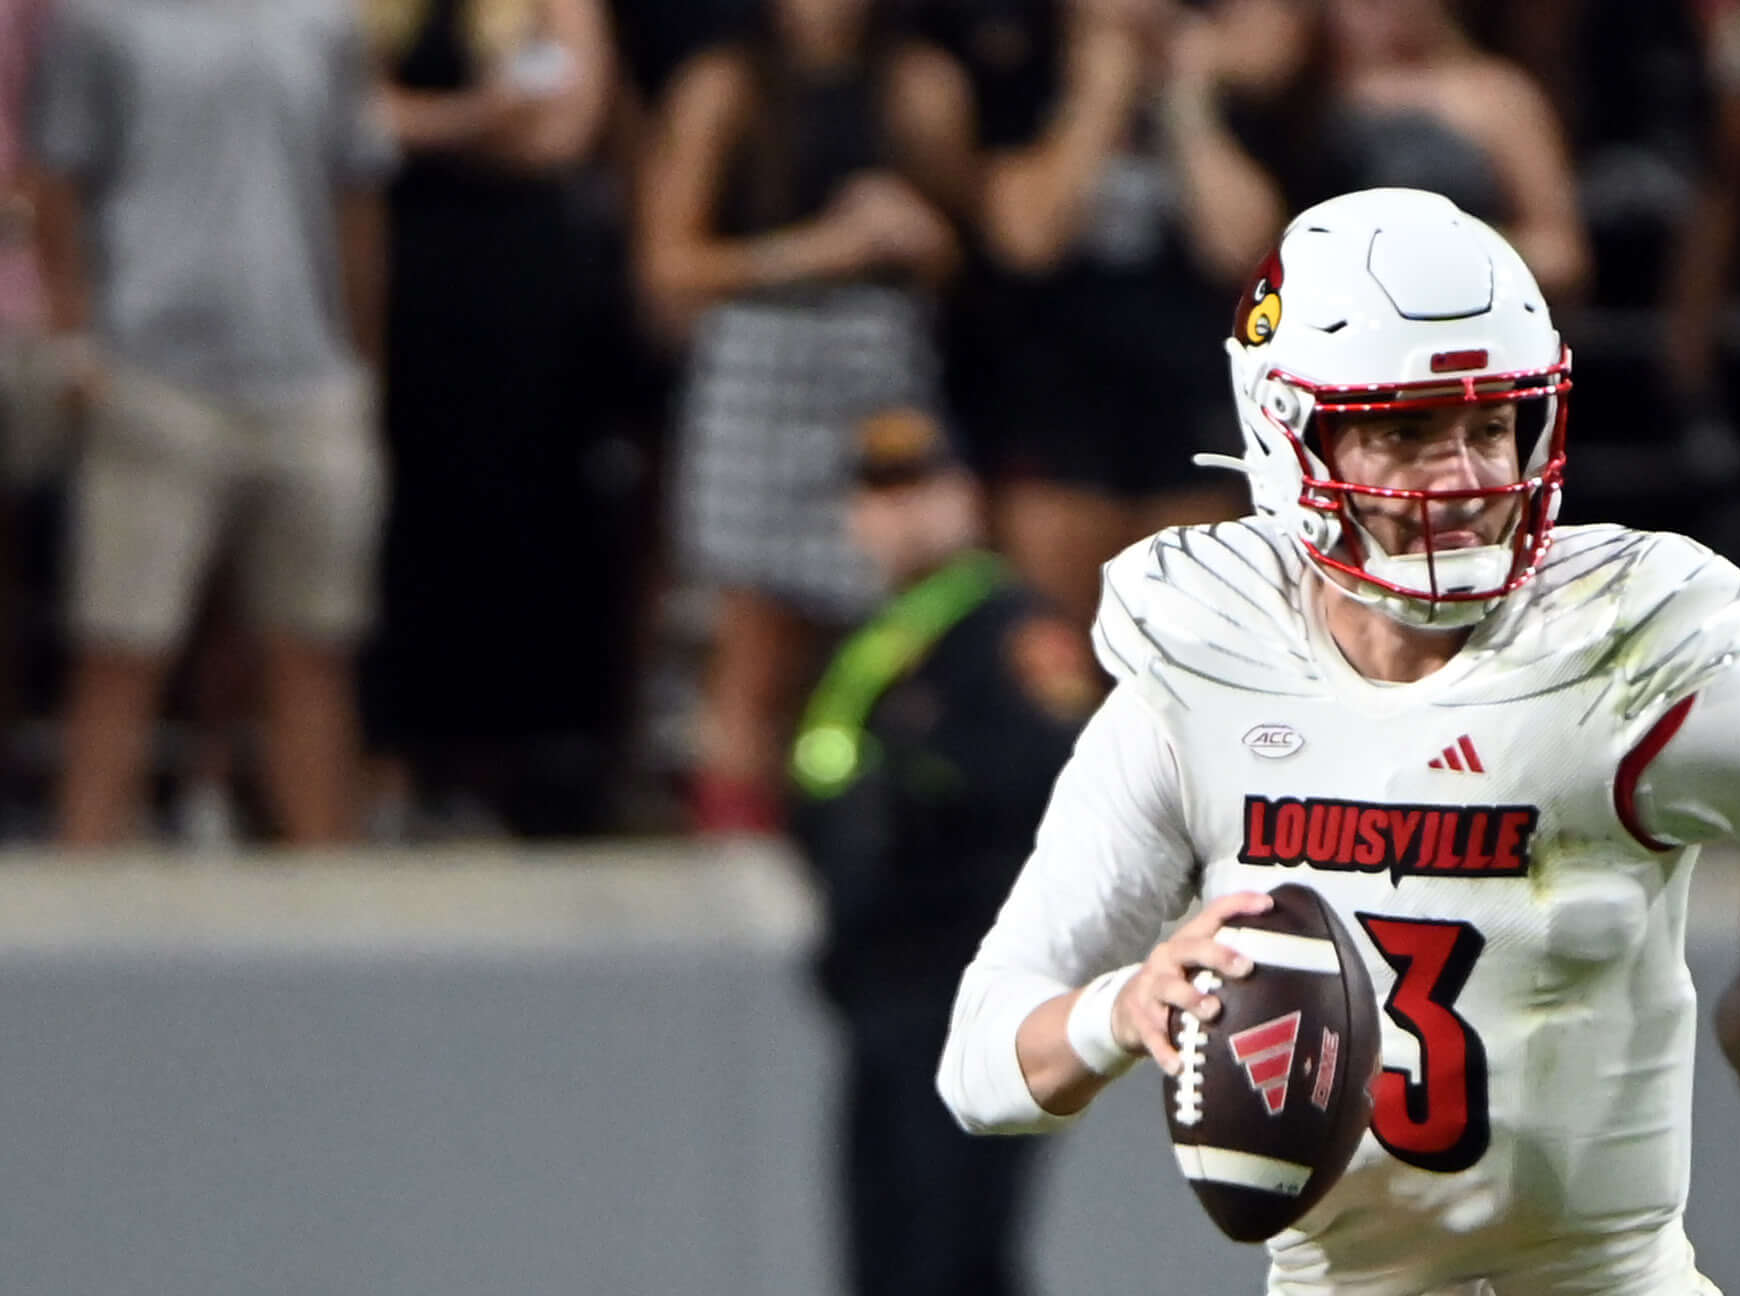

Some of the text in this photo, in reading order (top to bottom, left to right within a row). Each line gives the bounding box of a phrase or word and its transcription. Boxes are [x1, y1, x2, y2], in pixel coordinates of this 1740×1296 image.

[1252, 731, 1296, 745] ACC
[1240, 796, 1537, 882] LOUISVILLE
[1356, 911, 1489, 1173] 3
